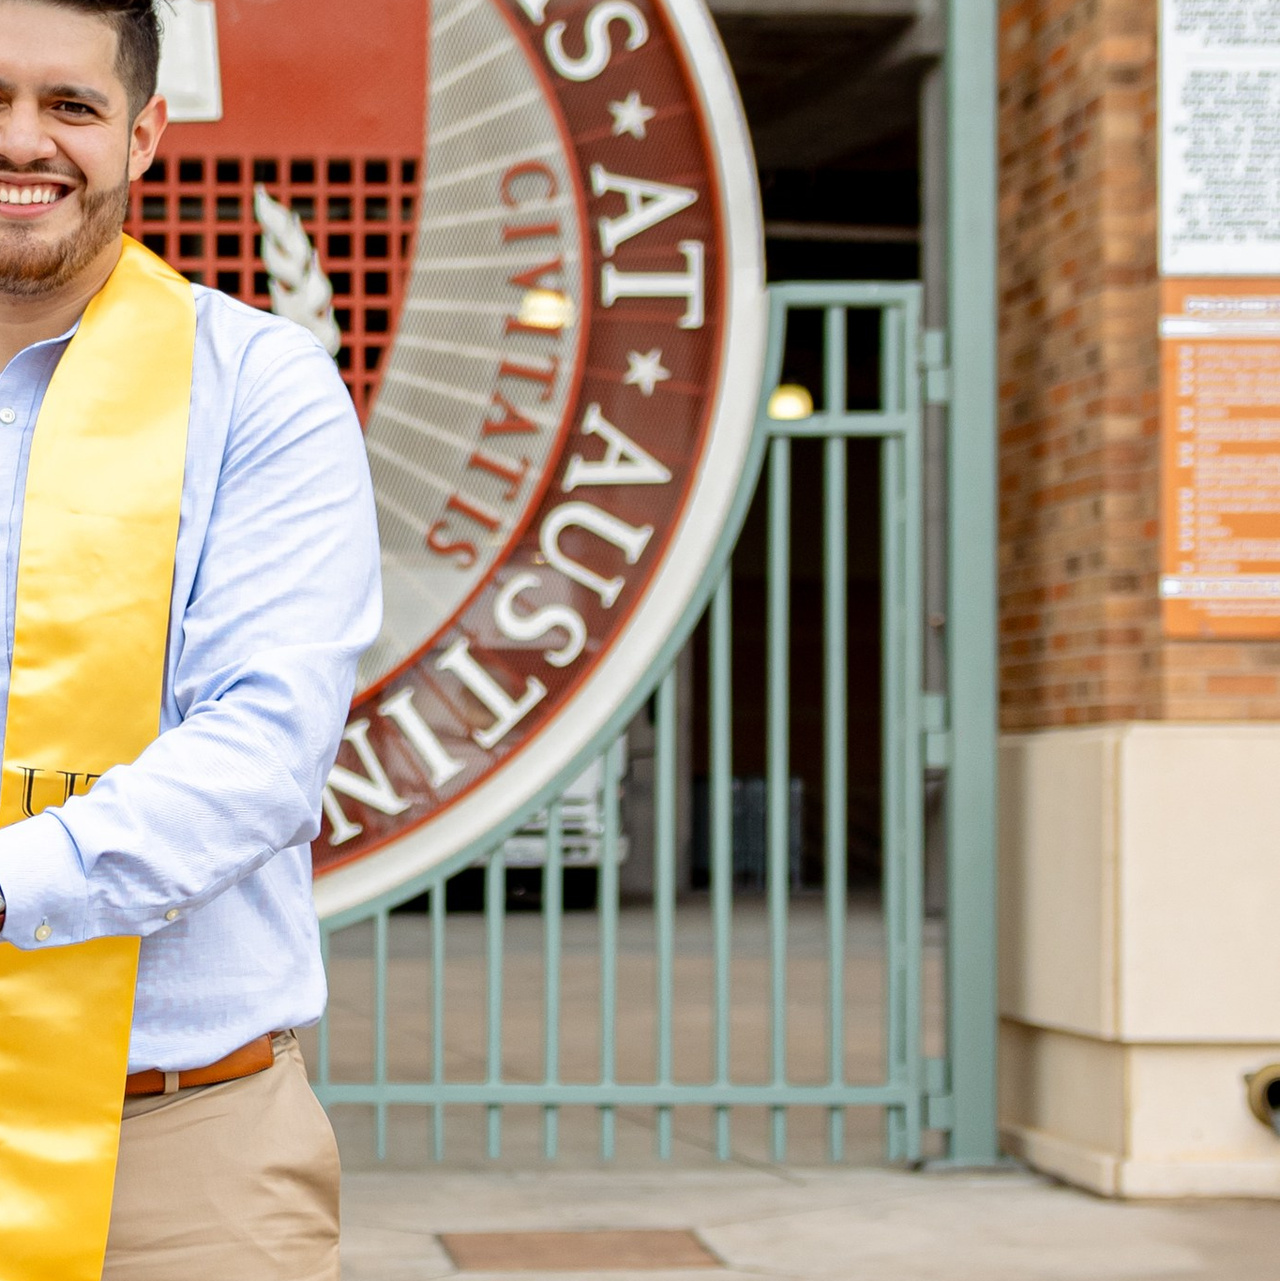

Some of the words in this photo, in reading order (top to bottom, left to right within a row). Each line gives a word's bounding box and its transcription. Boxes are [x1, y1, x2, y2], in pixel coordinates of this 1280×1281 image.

[590, 164, 705, 329] AT
[320, 402, 671, 846] AUSTIN
[16, 765, 101, 818] U
